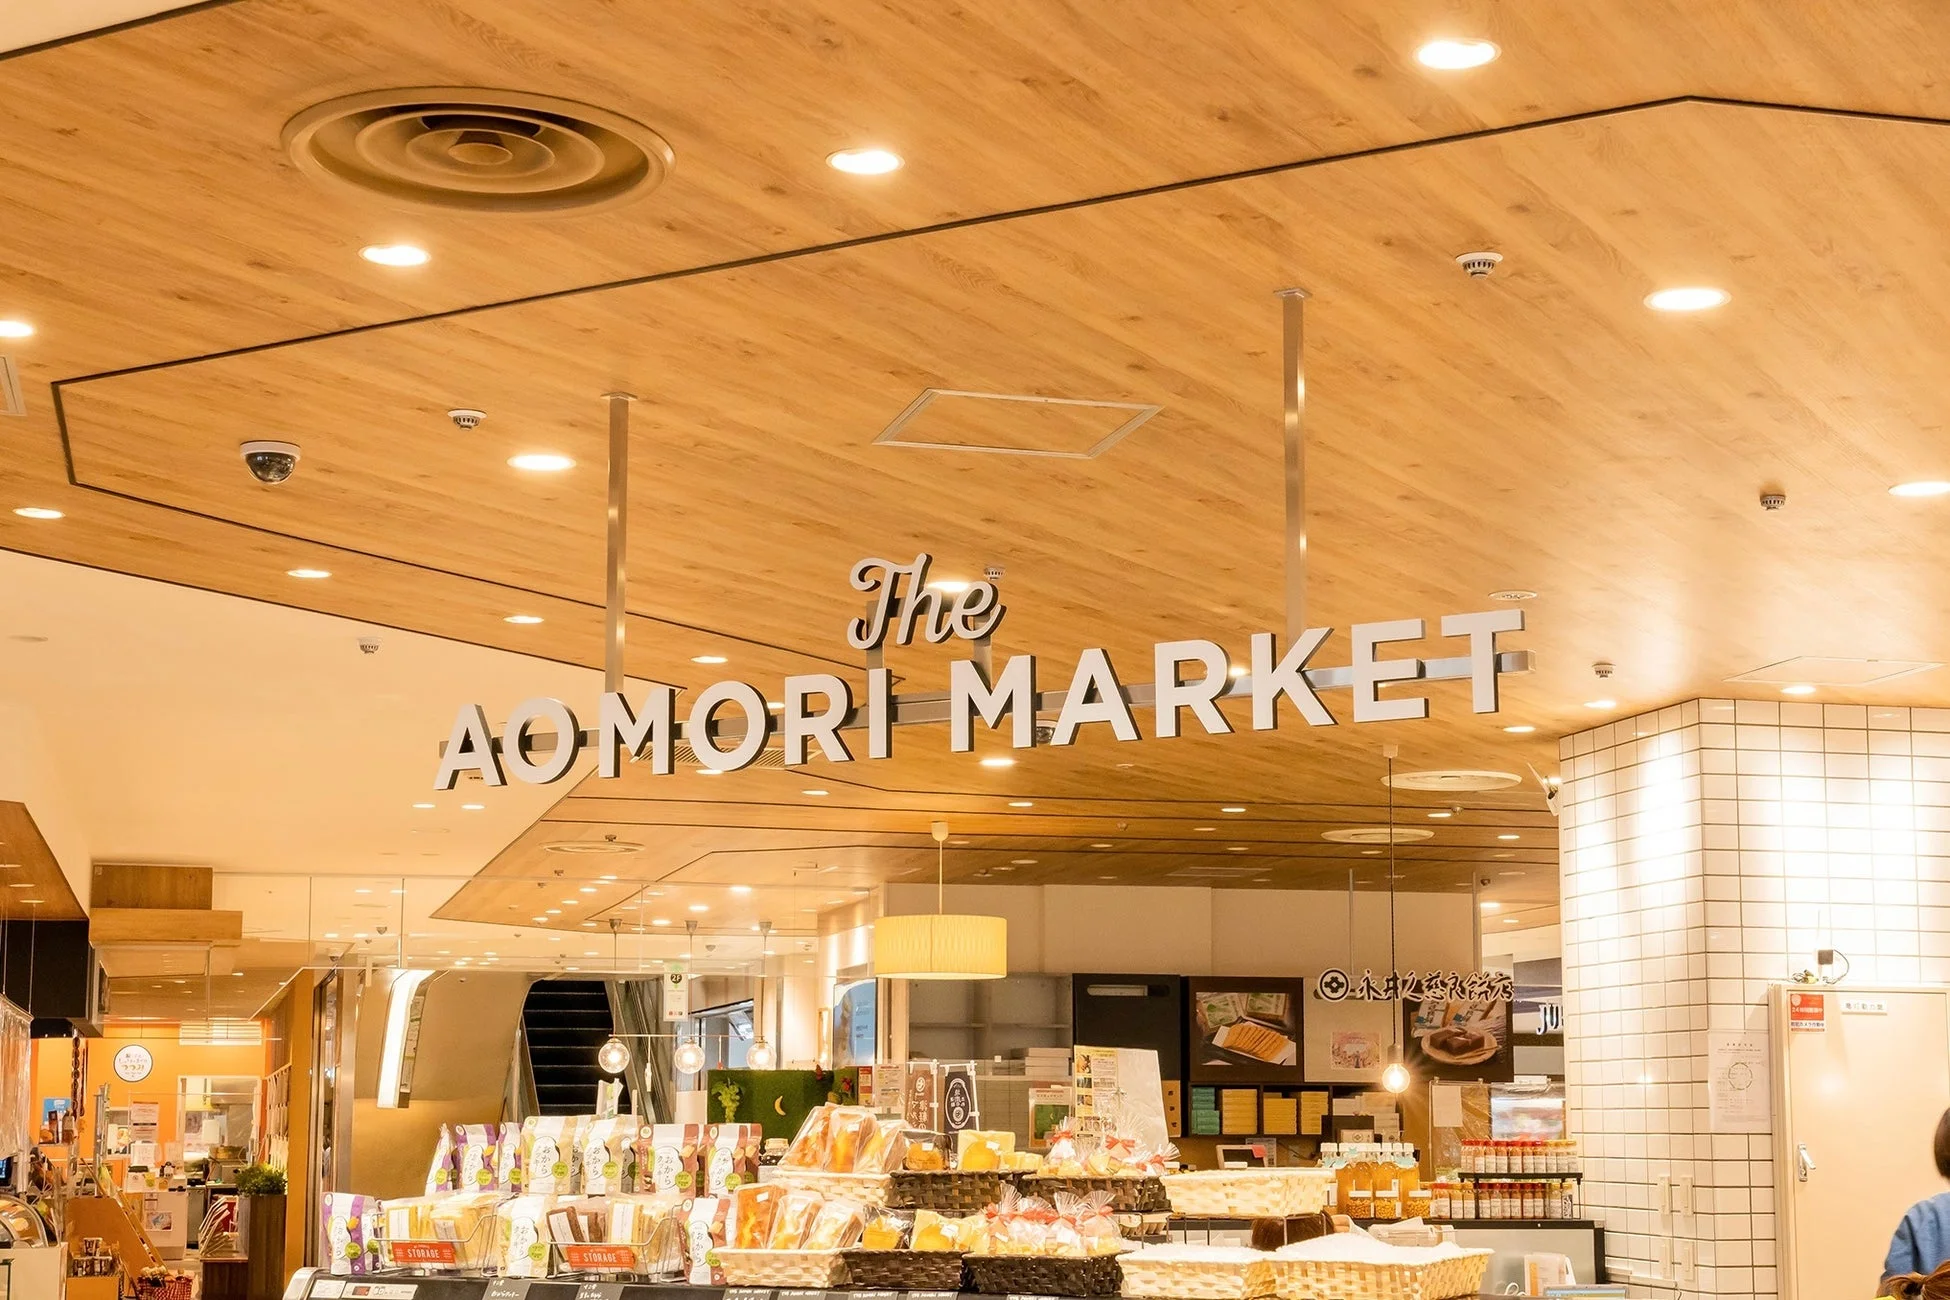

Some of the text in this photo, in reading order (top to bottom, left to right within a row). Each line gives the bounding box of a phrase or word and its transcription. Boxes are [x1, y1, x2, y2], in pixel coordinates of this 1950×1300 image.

[846, 553, 1006, 650] The
[433, 608, 1527, 790] AOMORI MARKET
[1536, 1004, 1563, 1035] JU
[407, 1248, 440, 1259] STORAGE
[583, 1252, 617, 1263] STORAGE
